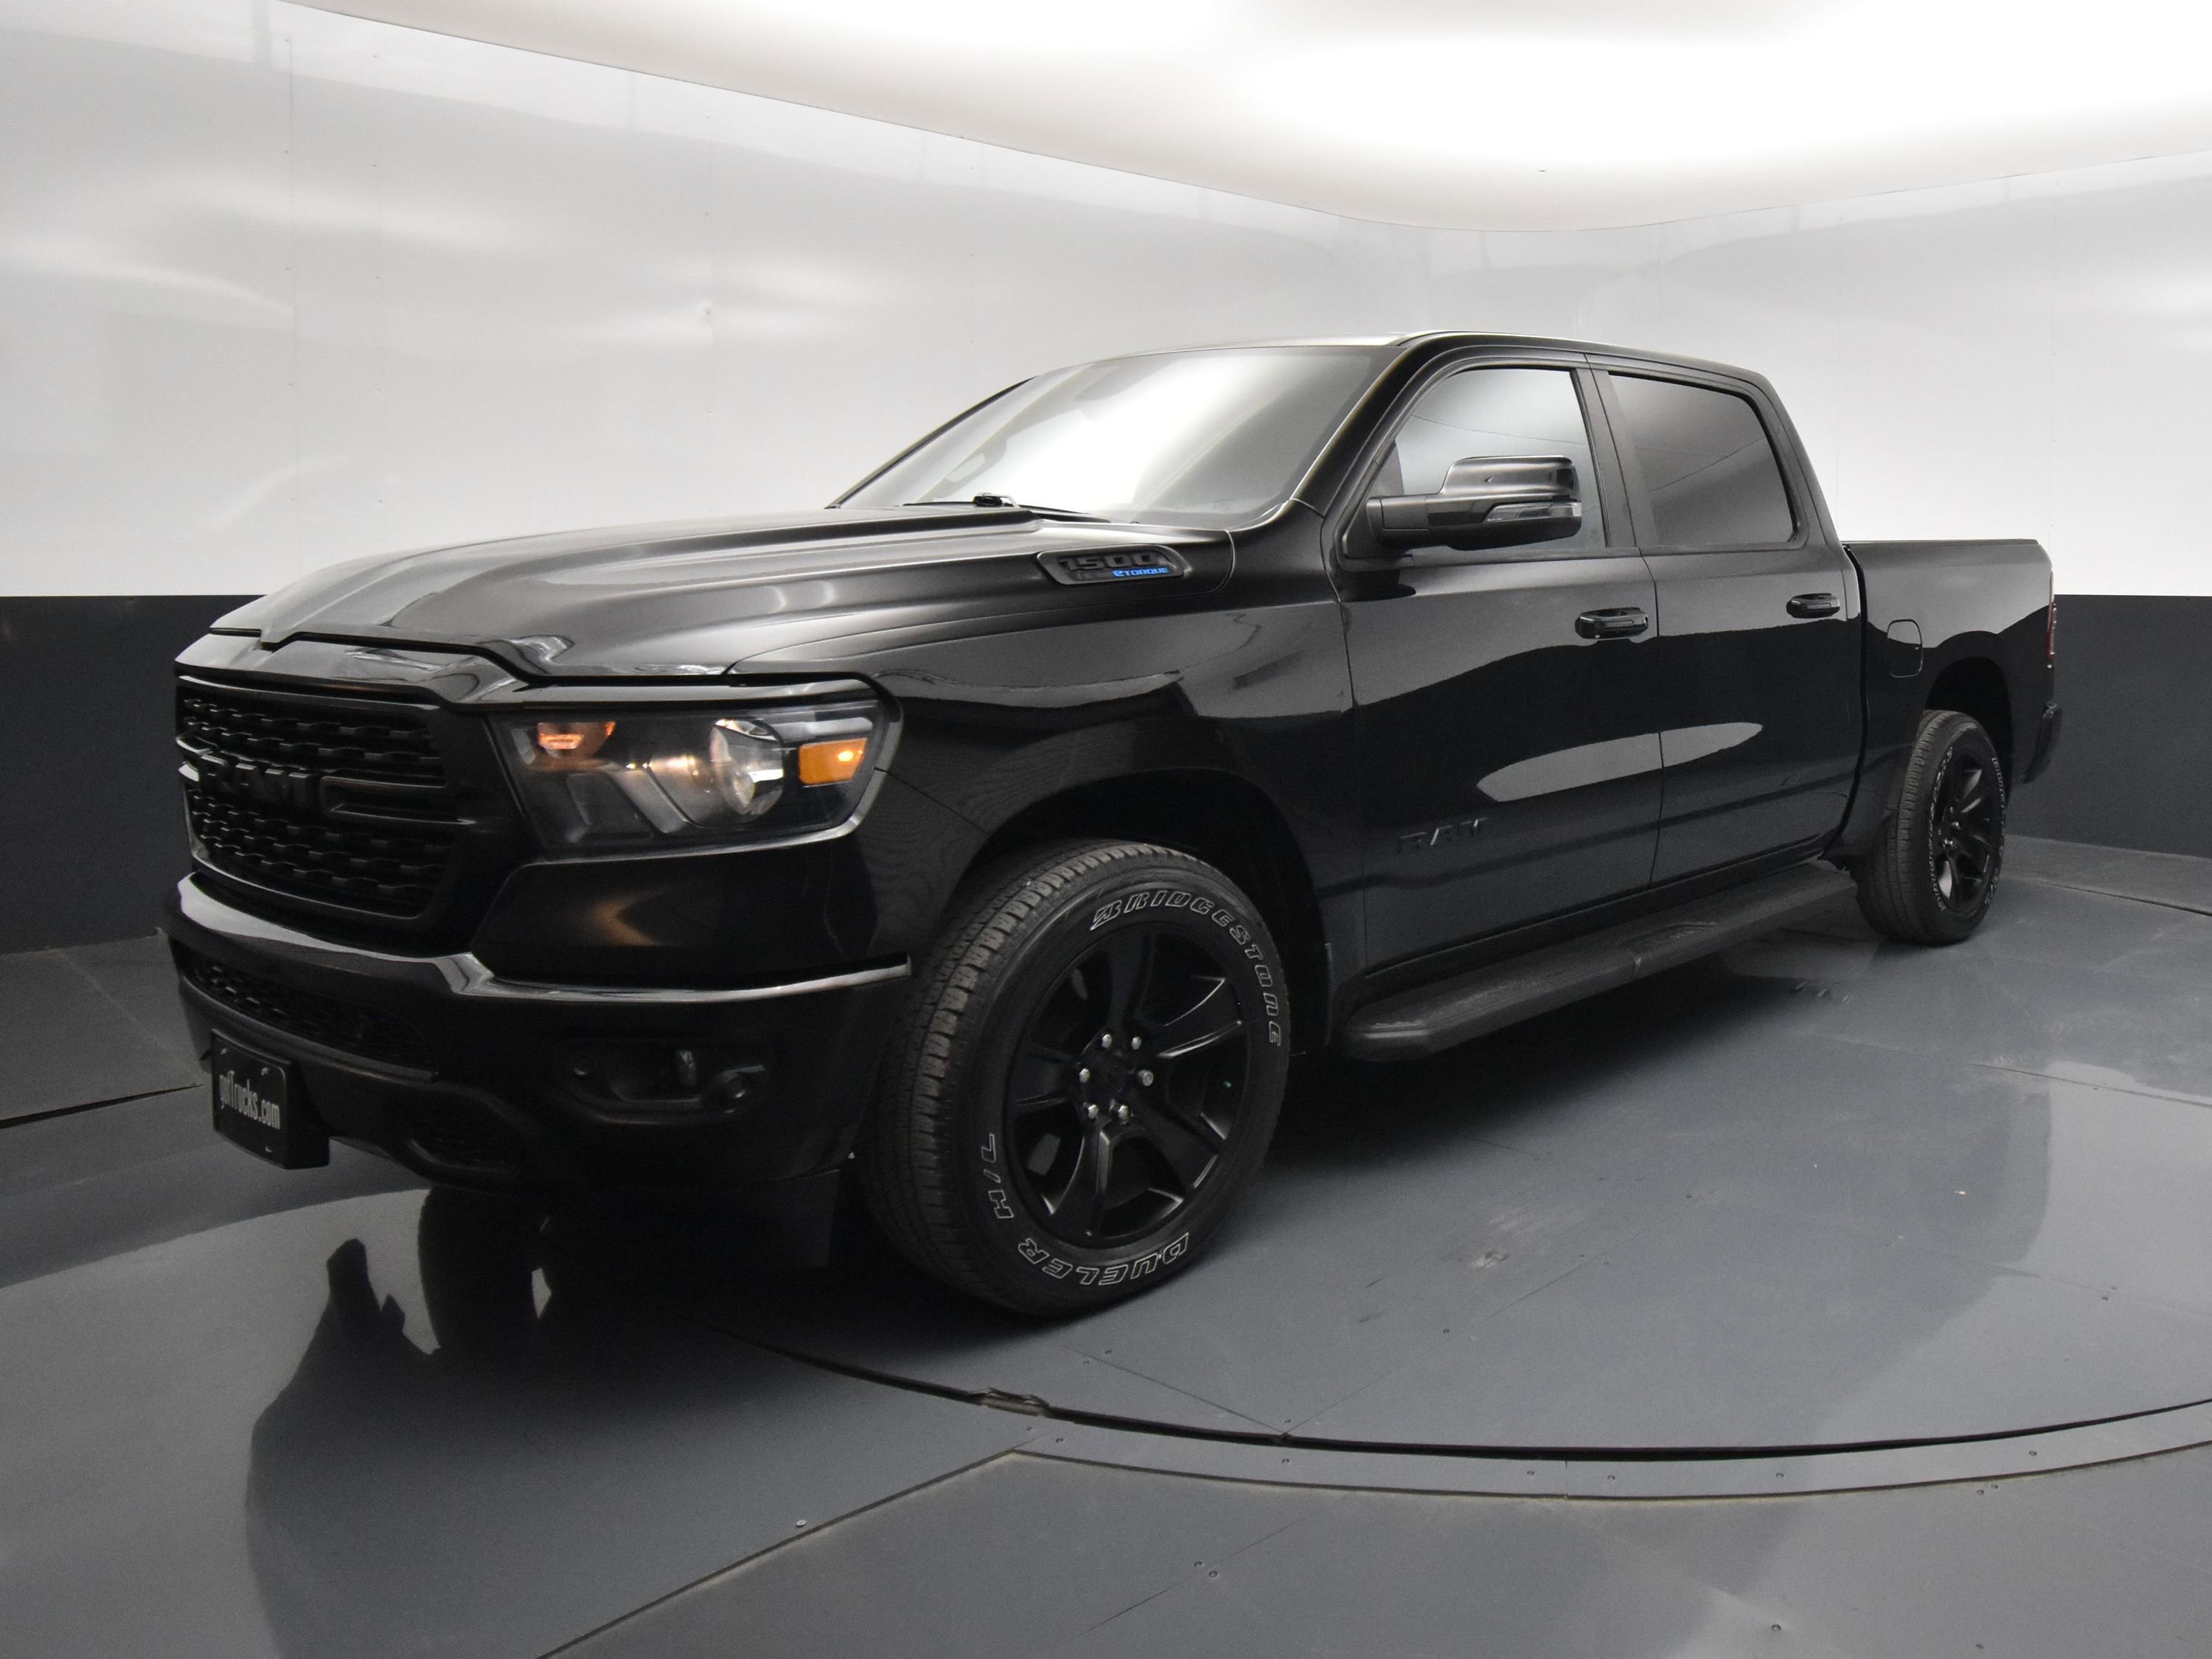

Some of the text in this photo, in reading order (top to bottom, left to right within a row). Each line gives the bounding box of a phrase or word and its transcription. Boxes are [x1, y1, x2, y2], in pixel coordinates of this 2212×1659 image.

[1058, 553, 1160, 571] 1500
[1090, 889, 1281, 1047] BRIDGESTONE
[1018, 1231, 1189, 1286] DUELER
